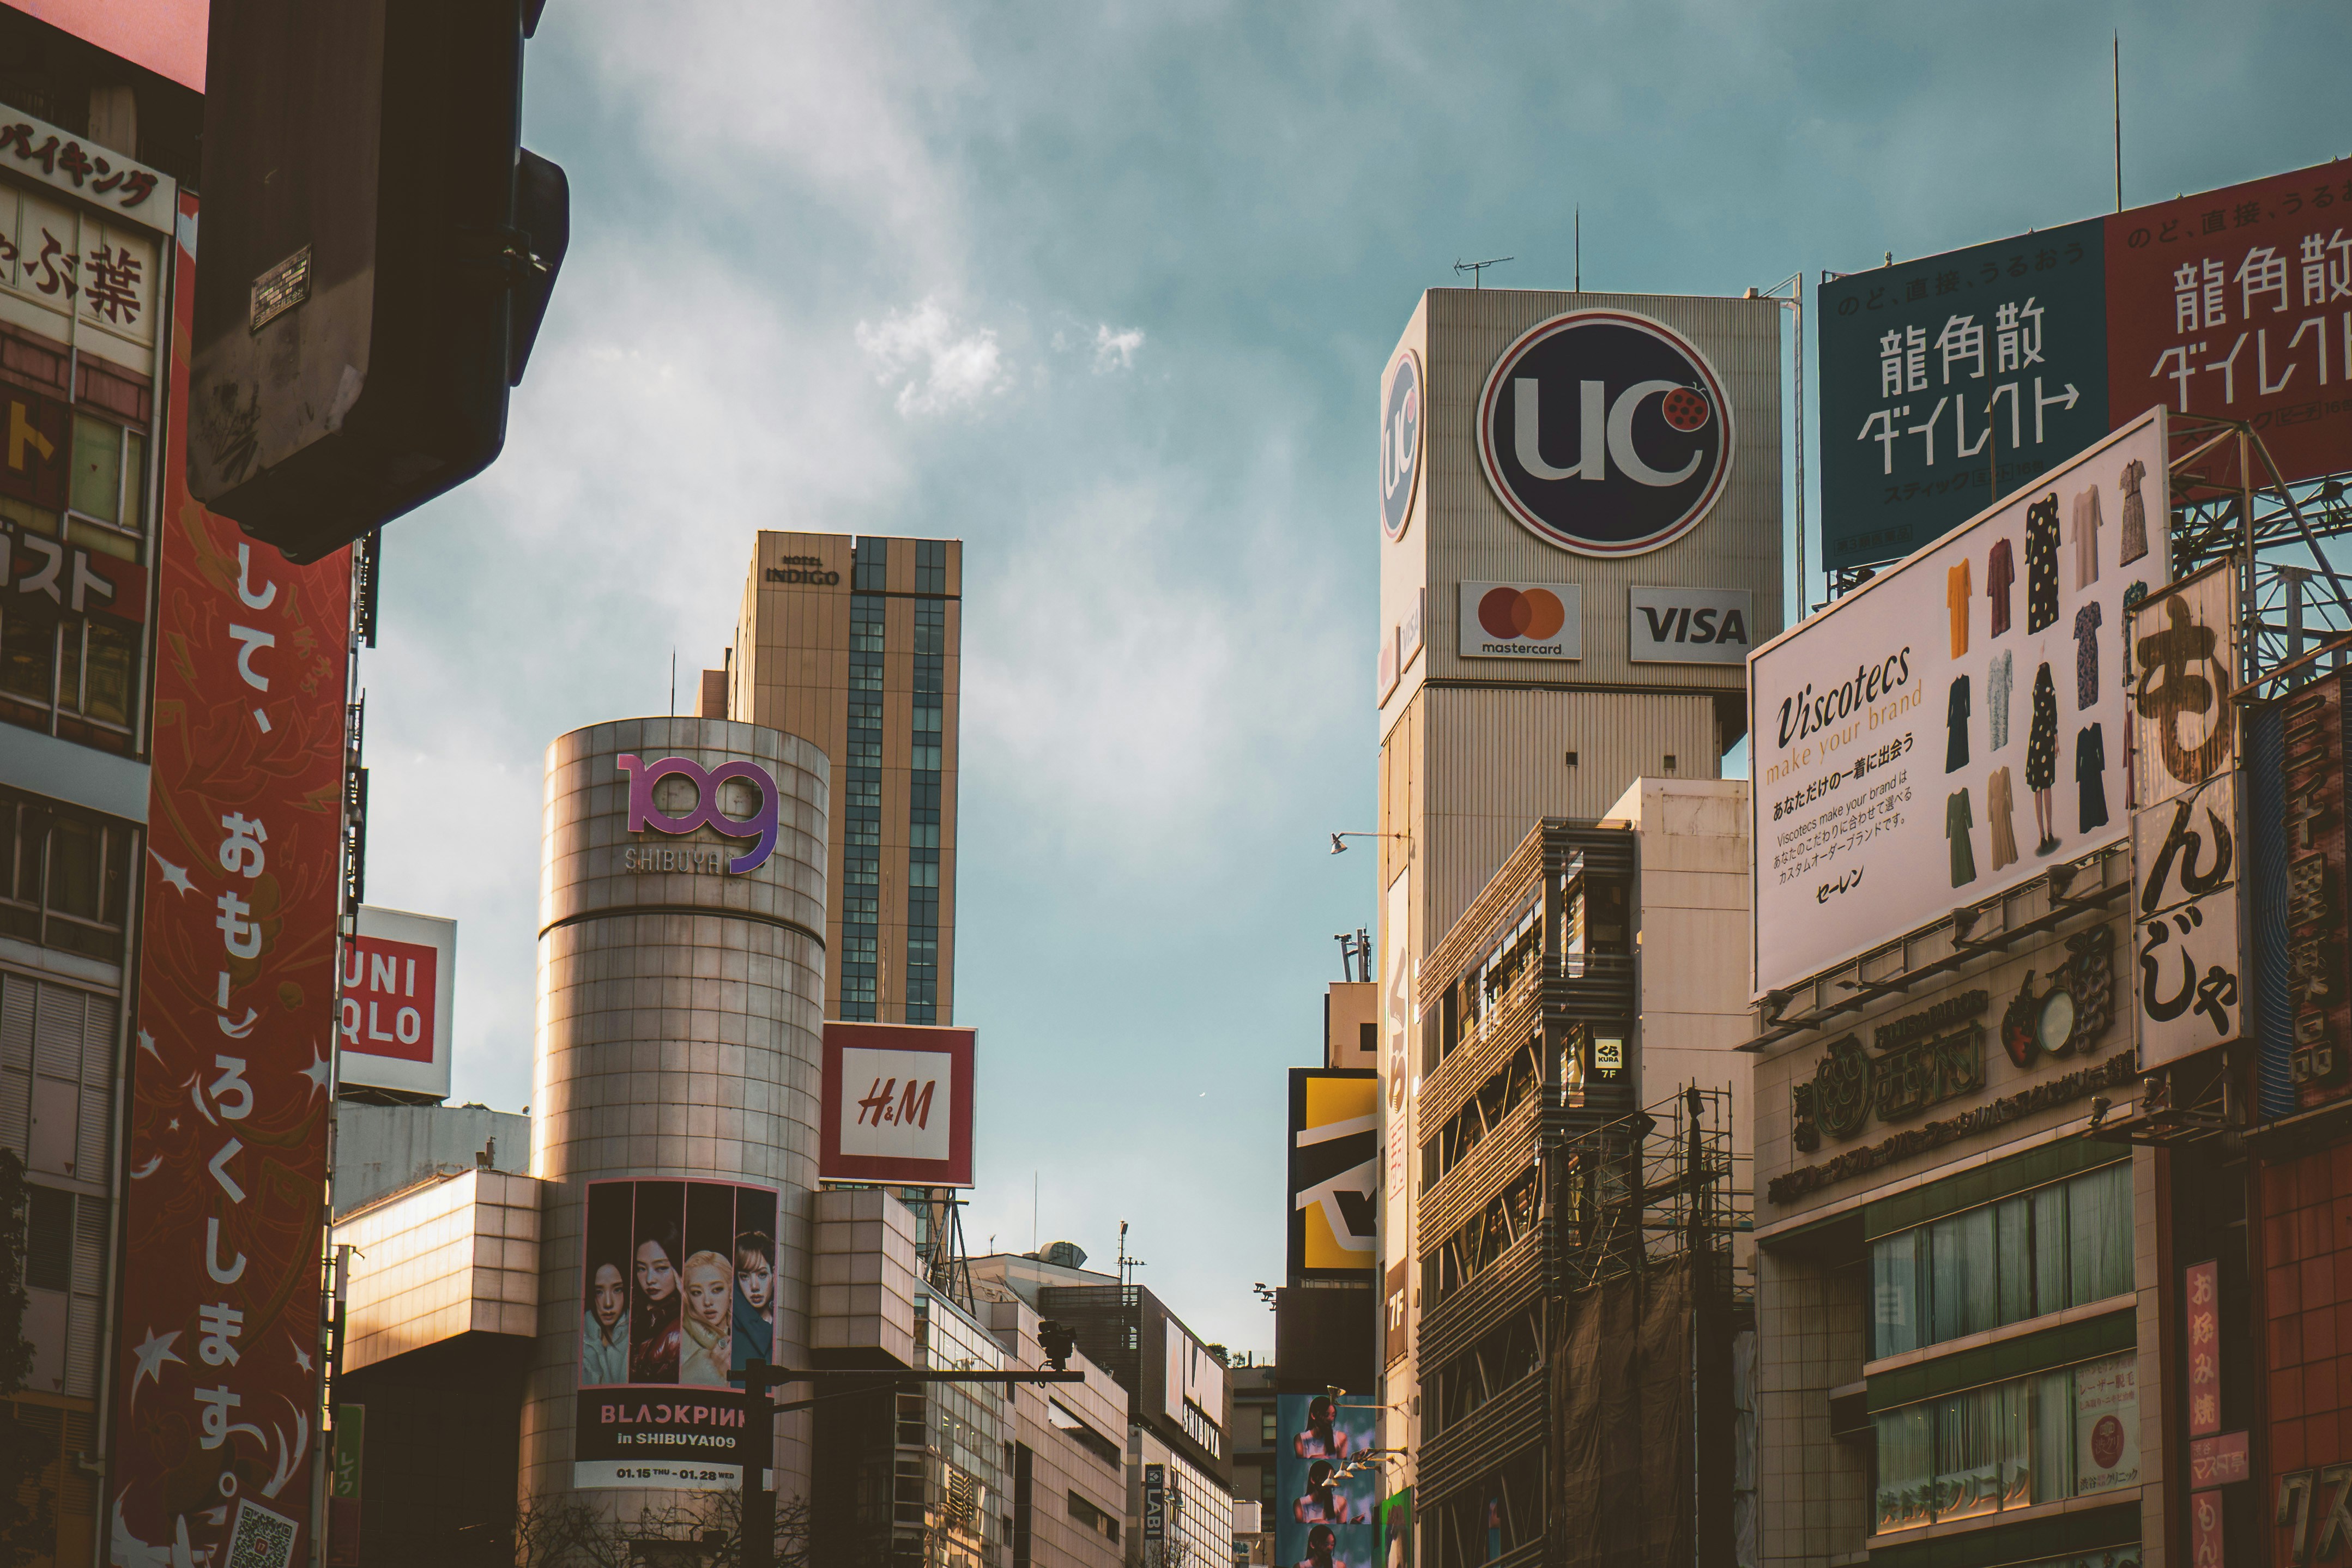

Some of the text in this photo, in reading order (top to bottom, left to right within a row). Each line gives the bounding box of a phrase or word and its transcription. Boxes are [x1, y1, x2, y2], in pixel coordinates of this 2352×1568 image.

[0, 124, 158, 207] バイキング
[1837, 242, 2084, 316] のど、直接、うるおう
[2174, 228, 2352, 334] 龍角散
[1880, 297, 2045, 398] 龍角散
[1857, 376, 2079, 475] ダイレクト
[1884, 471, 1968, 505] スティック
[766, 568, 839, 586] INDIGO
[783, 555, 823, 567] HOTEL
[1402, 608, 1419, 651] VISA
[1482, 641, 1562, 656] mastercard
[1636, 607, 1748, 645] VISA
[1776, 646, 1910, 749] Viscotecs
[1767, 679, 1922, 785] make your brand
[1773, 732, 1913, 821] あなただけの一着に出会う
[618, 754, 779, 874] 109
[1773, 786, 1912, 870] あなたのこだわりに合わせて選べる
[1777, 769, 1907, 848] Viscotecs make your brand は
[2136, 594, 2239, 1036] もんじゃ
[625, 848, 718, 874] SHIBUYA
[1779, 814, 1905, 885] カスタムオーダーブランドです。
[1816, 865, 1865, 904] セーレン
[343, 949, 415, 997] UNI
[341, 997, 421, 1045] QLO
[1598, 1045, 1619, 1056] くら
[1601, 1070, 1616, 1078] 7F
[857, 1077, 936, 1130] H&M
[1389, 1287, 1404, 1331] 7F
[2079, 1371, 2135, 1396] レーザー脱毛
[618, 1433, 736, 1449] in SHIBUYA109
[1183, 1403, 1220, 1461] SHIBUYA
[338, 1452, 354, 1495] レイク
[616, 1468, 651, 1479] 01.15
[679, 1469, 717, 1481] 01.28
[1147, 1489, 1161, 1535] LABI
